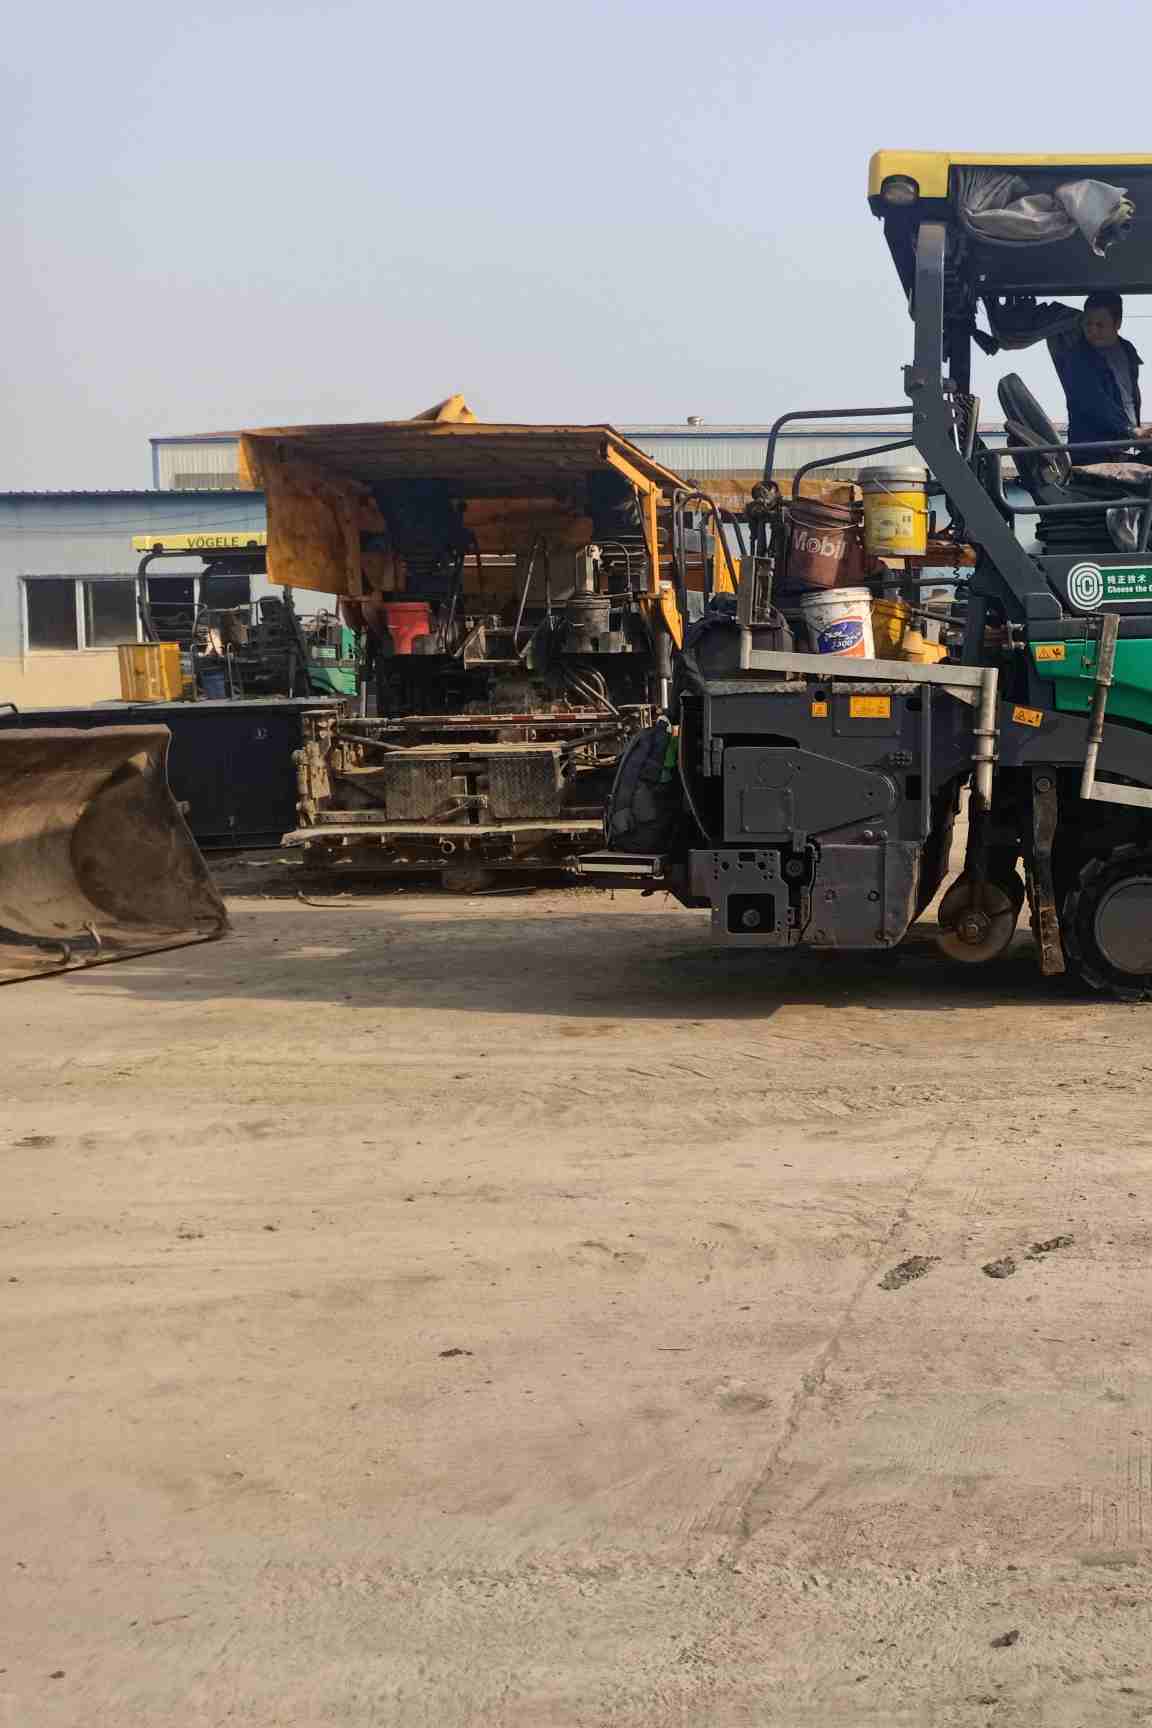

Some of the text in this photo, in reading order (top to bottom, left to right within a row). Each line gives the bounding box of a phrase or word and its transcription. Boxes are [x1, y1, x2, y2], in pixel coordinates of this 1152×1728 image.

[792, 529, 846, 560] Mobil
[1107, 585, 1134, 594] Choose
[1135, 585, 1148, 593] the
